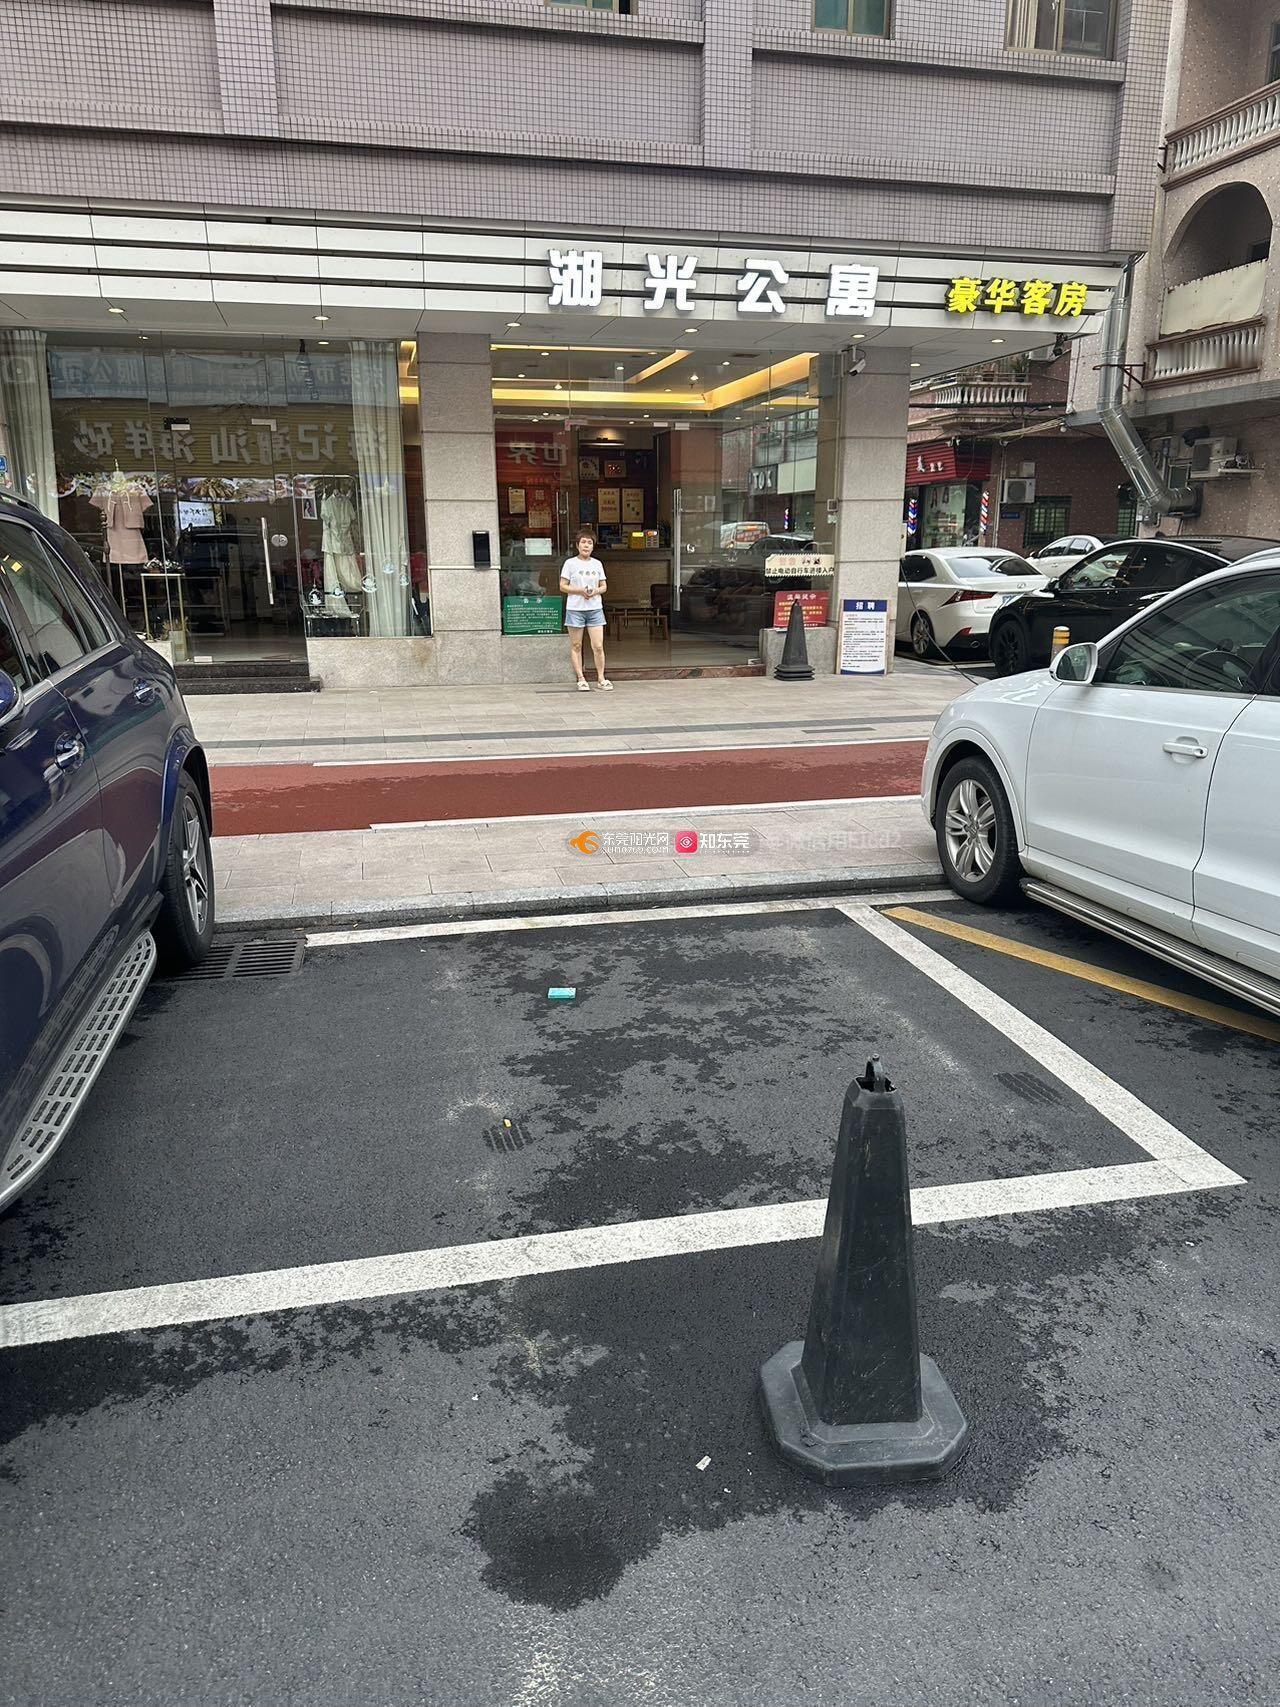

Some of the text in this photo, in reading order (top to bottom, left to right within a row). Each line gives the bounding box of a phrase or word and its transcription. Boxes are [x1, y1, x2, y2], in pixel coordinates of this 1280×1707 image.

[547, 249, 880, 320] 湖光公寓
[946, 276, 1089, 318] 豪华客房
[855, 601, 876, 610] 招聘
